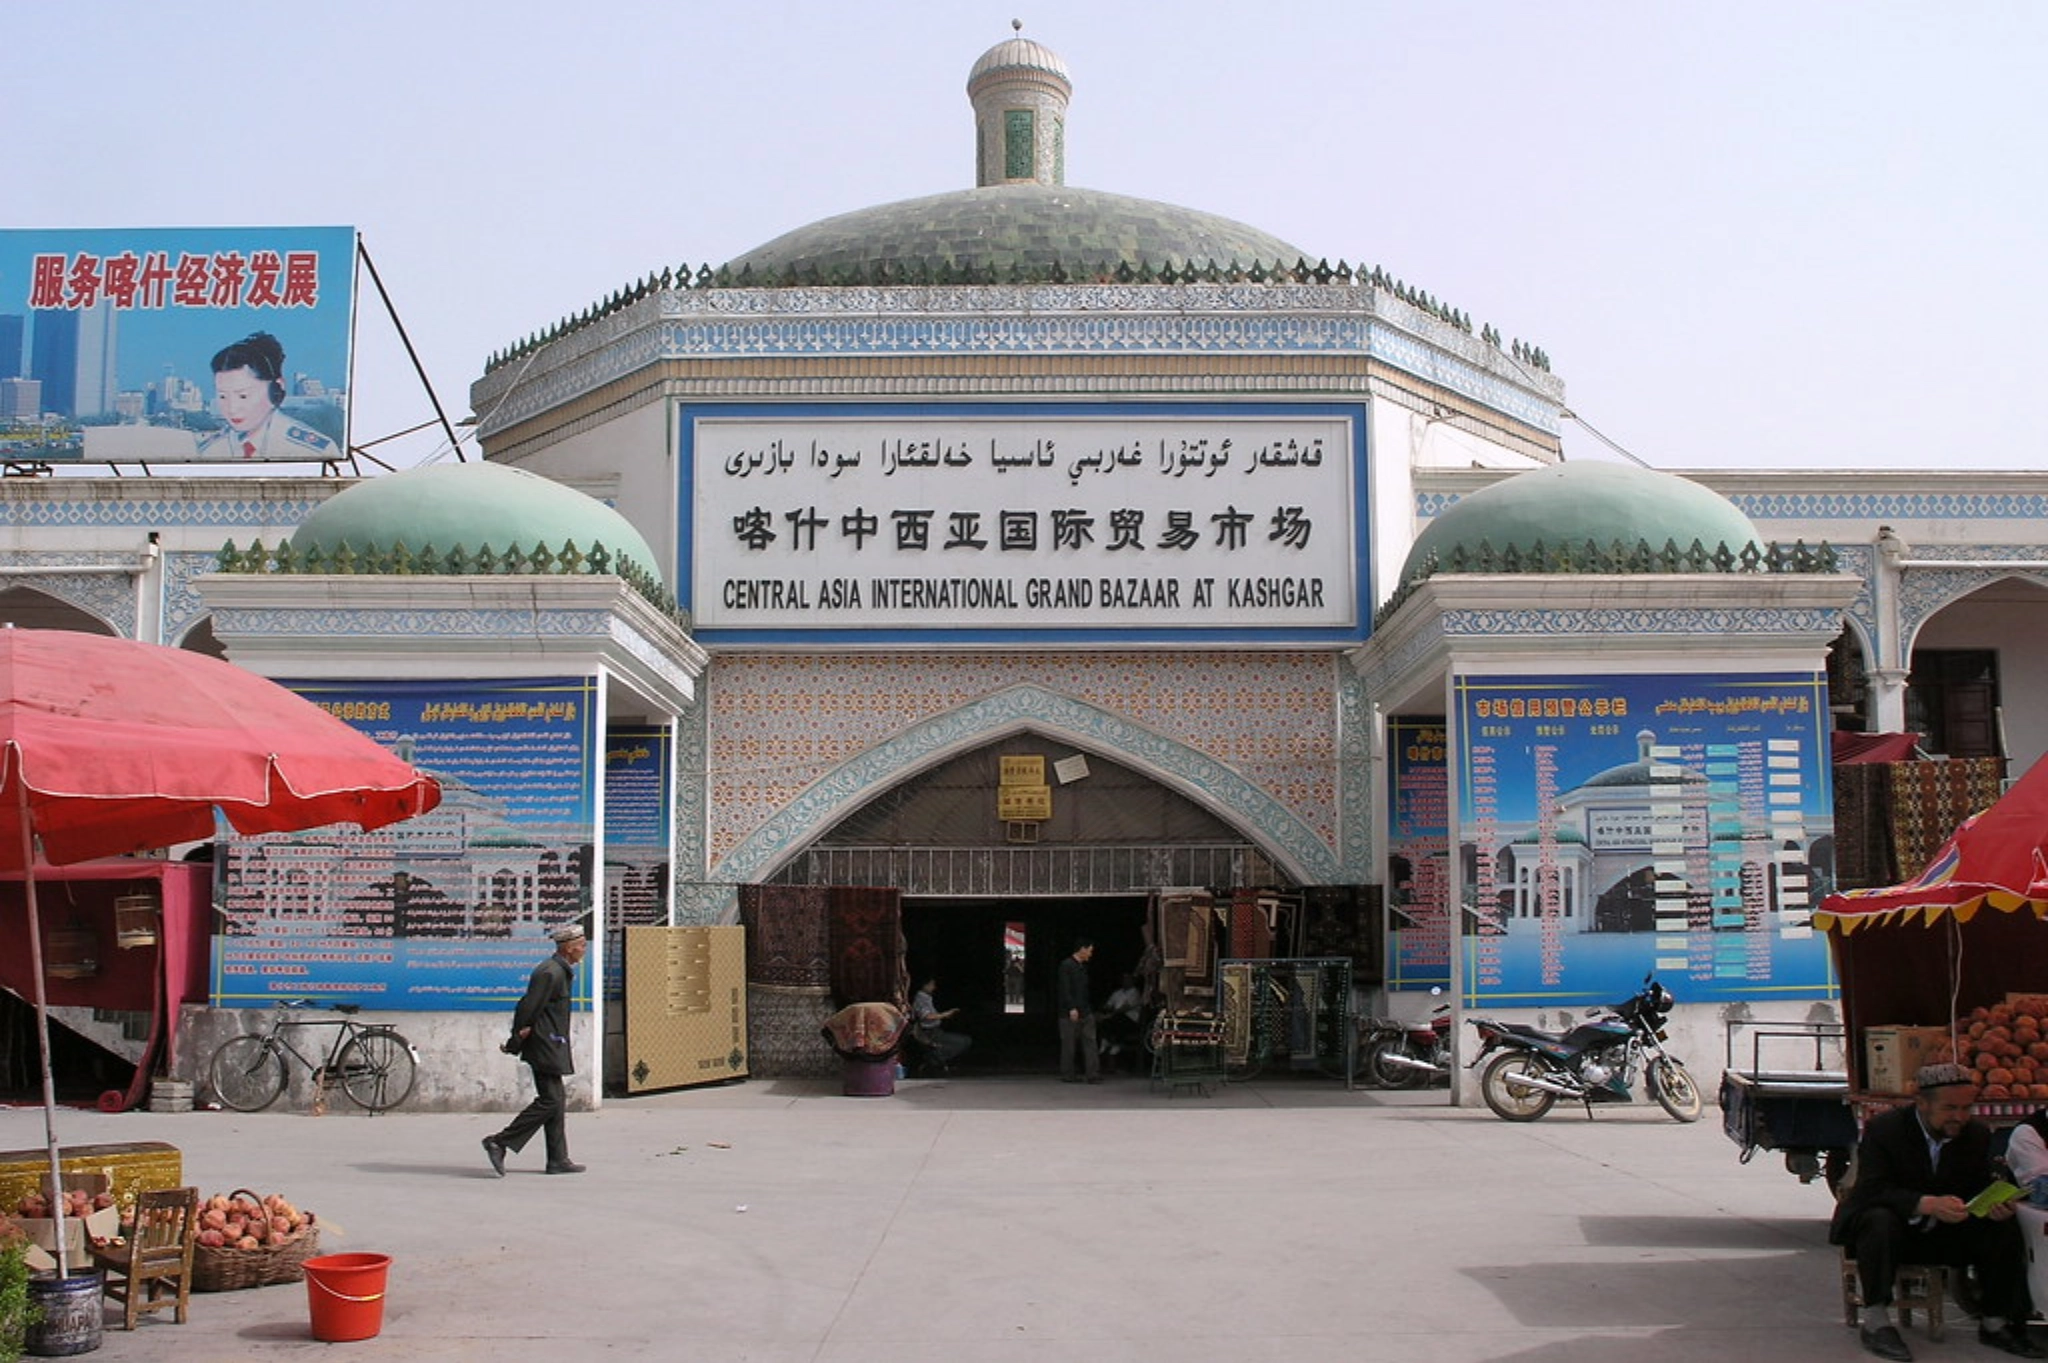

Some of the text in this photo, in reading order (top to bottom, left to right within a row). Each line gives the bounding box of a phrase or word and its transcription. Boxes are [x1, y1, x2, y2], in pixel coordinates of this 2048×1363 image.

[31, 253, 317, 307] 服务喀什经济发展
[811, 440, 861, 479] سودا
[1160, 438, 1233, 478] ئوتتۇرا
[1243, 438, 1323, 475] قەشقەر
[732, 504, 1312, 552] 喀什中西亚国际贸易市场
[723, 576, 1325, 610] CENTRAL ASIA INTERNATIONAL GRAND BAZAAR AT KASHGAR
